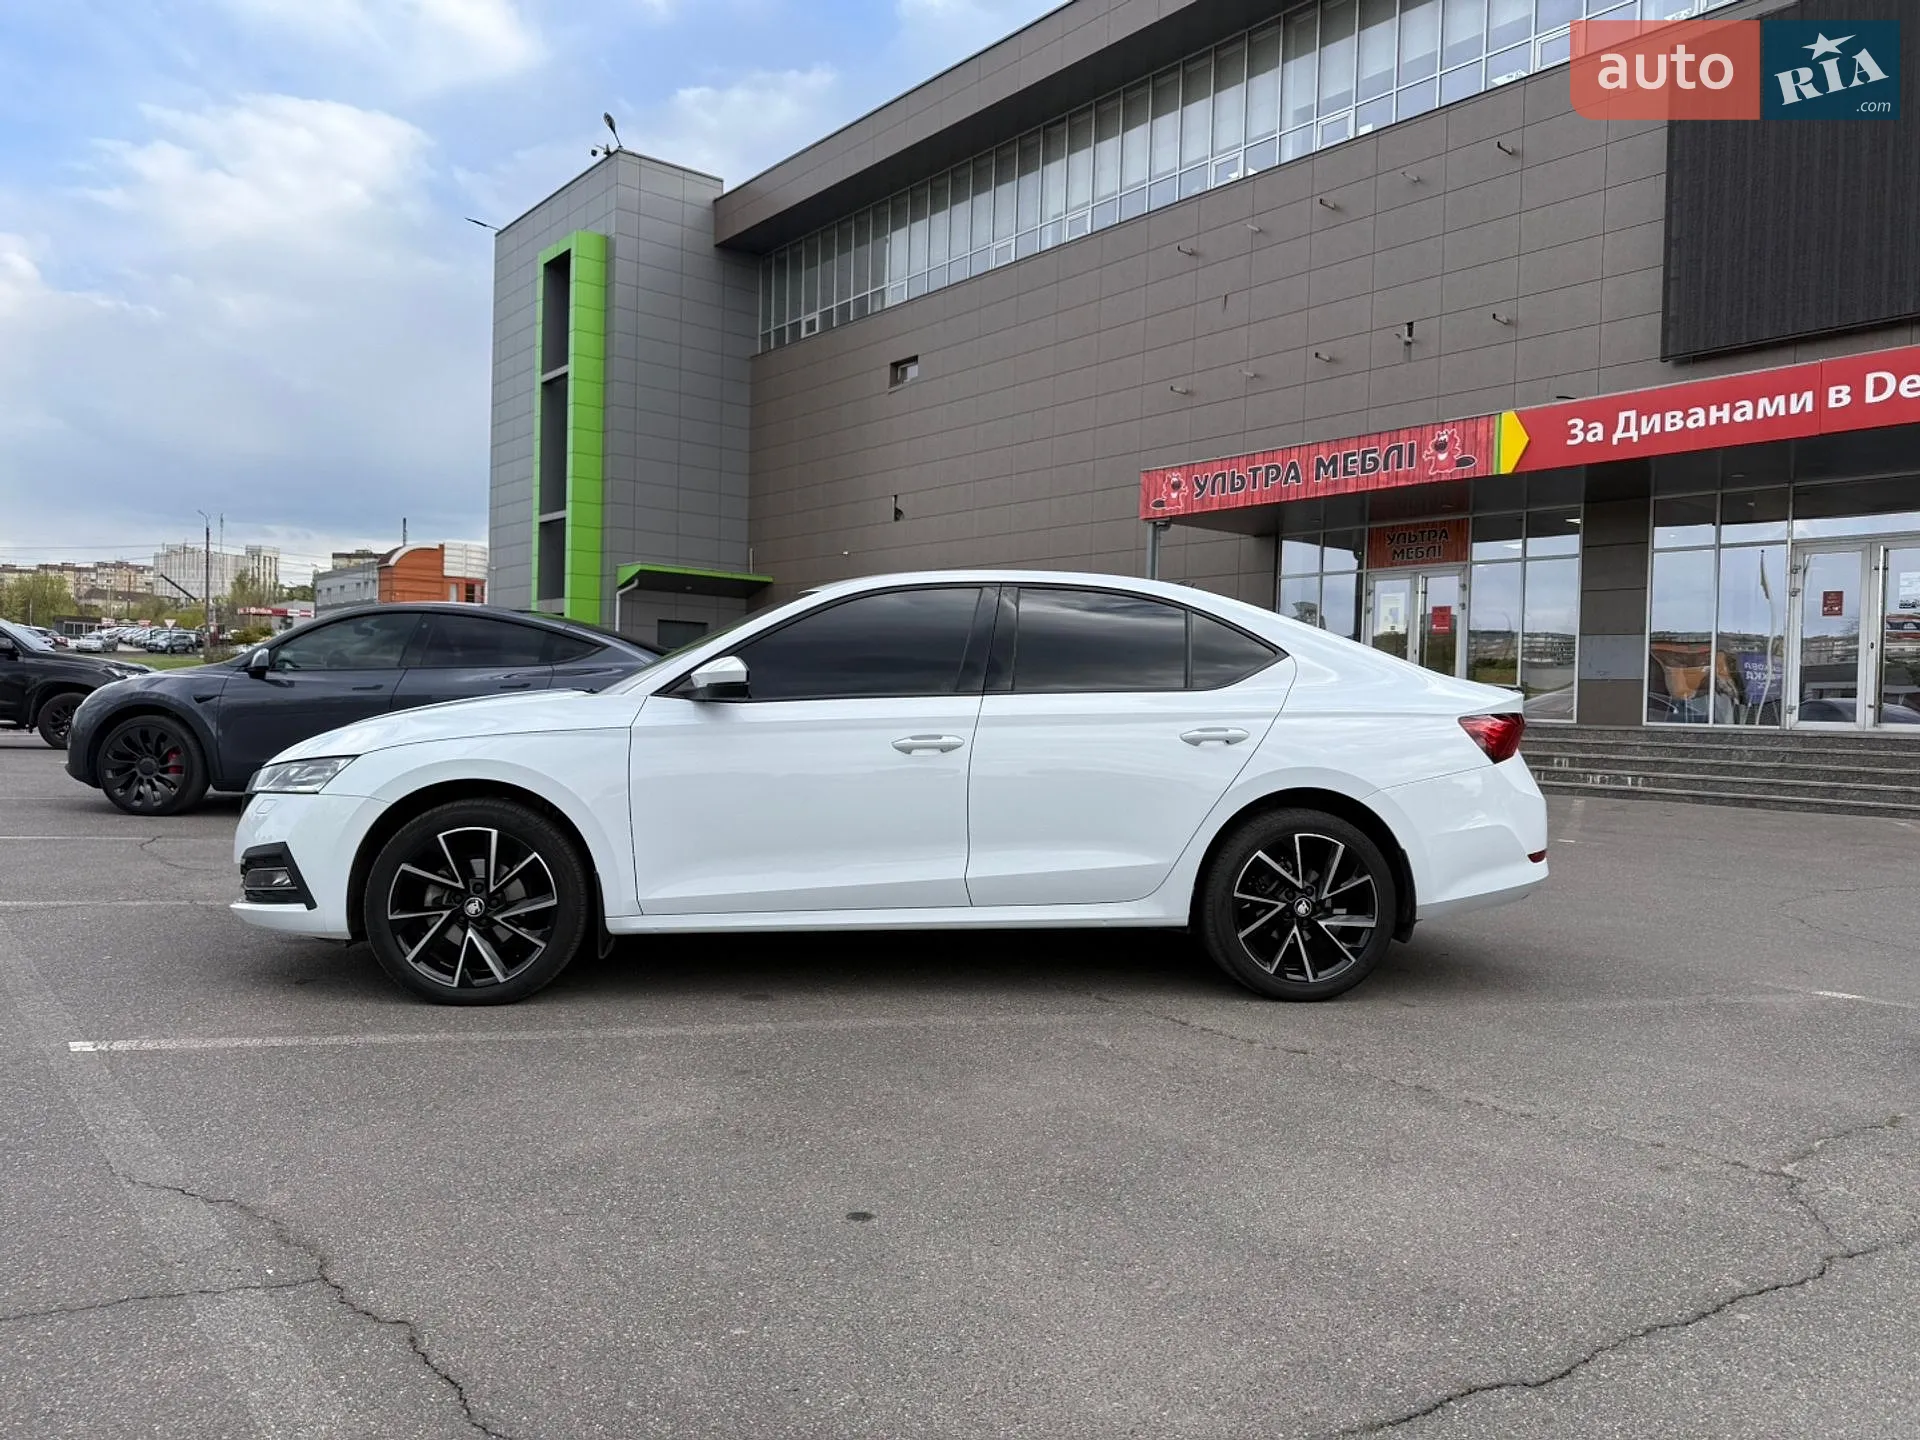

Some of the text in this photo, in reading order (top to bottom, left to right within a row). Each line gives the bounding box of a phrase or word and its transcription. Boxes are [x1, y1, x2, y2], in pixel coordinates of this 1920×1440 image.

[1566, 418, 1604, 446] За
[1612, 390, 1813, 446] Диванами
[1828, 384, 1851, 409] в
[1193, 441, 1417, 499] УЛЬТРА МЕБЛІ
[1386, 528, 1449, 545] УЛЬТРА
[1392, 545, 1443, 560] МЕБЛІ
